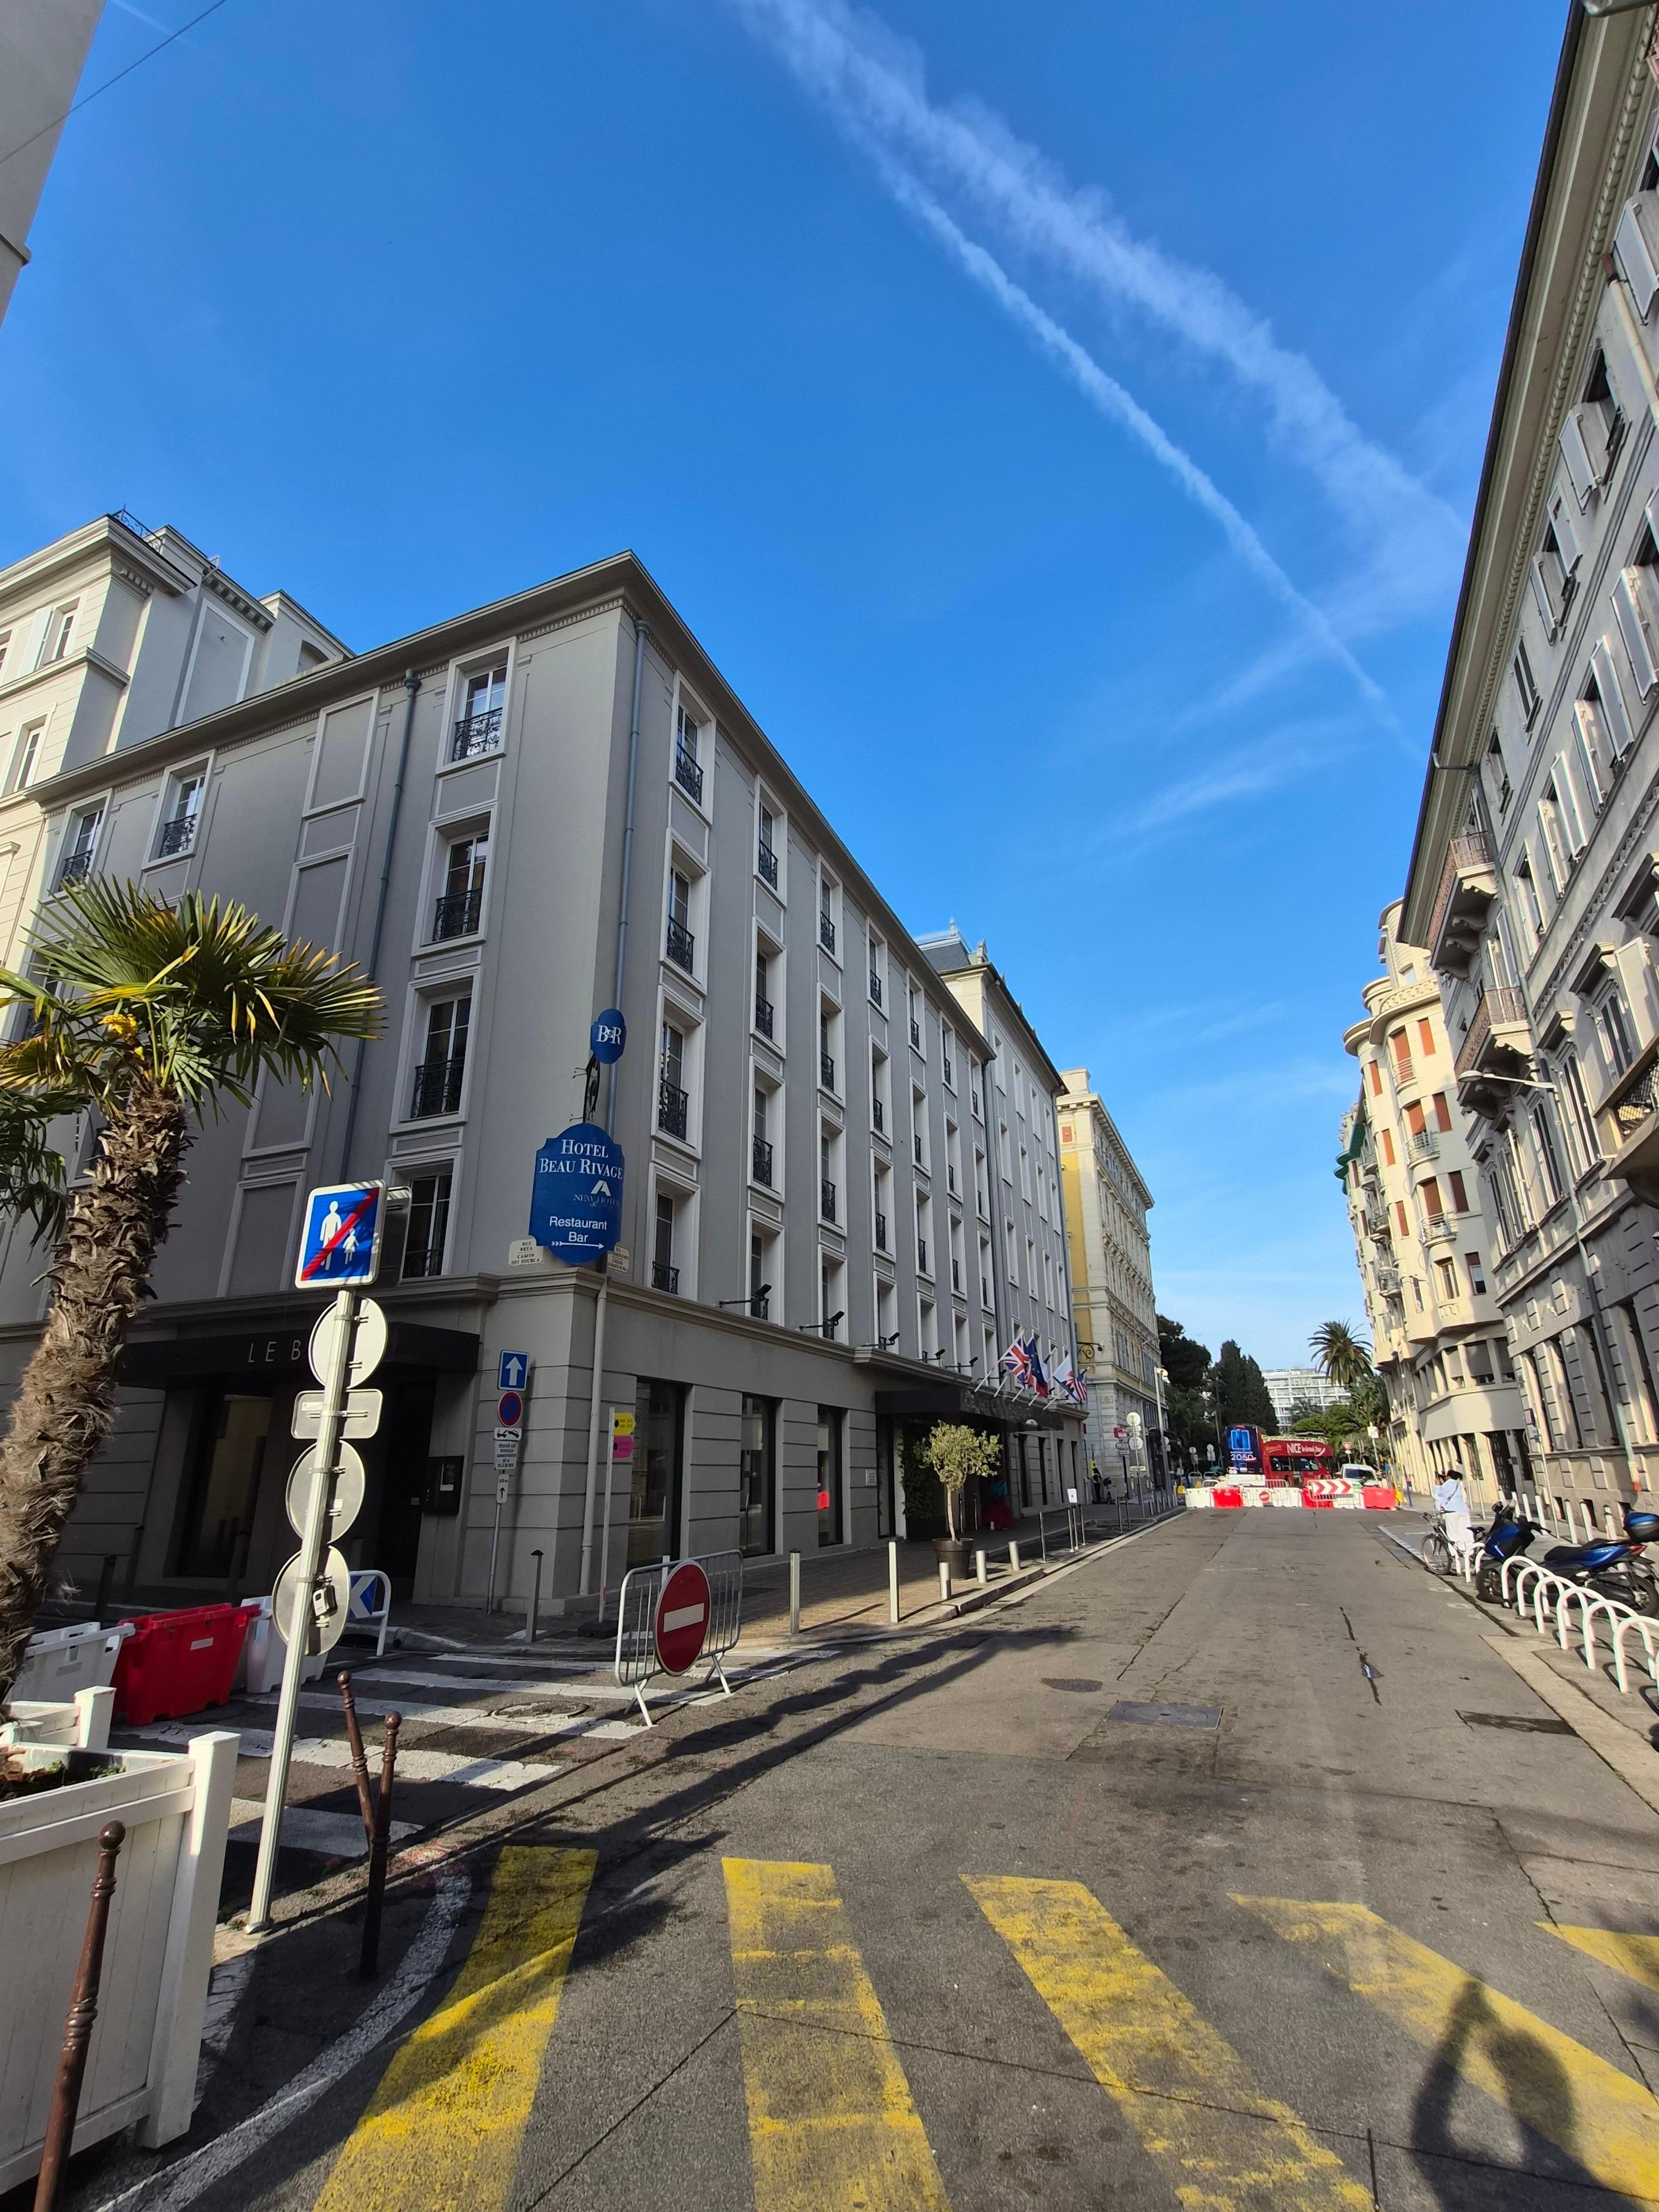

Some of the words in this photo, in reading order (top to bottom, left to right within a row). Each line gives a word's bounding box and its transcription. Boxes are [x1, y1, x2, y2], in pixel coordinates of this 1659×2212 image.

[560, 1139, 609, 1159] HOTEL
[539, 1158, 576, 1173] BEAU
[579, 1159, 623, 1180] RIVAGE
[550, 1216, 607, 1230] Restaurant
[568, 1232, 588, 1243] Bar
[1287, 1443, 1301, 1454] NICE
